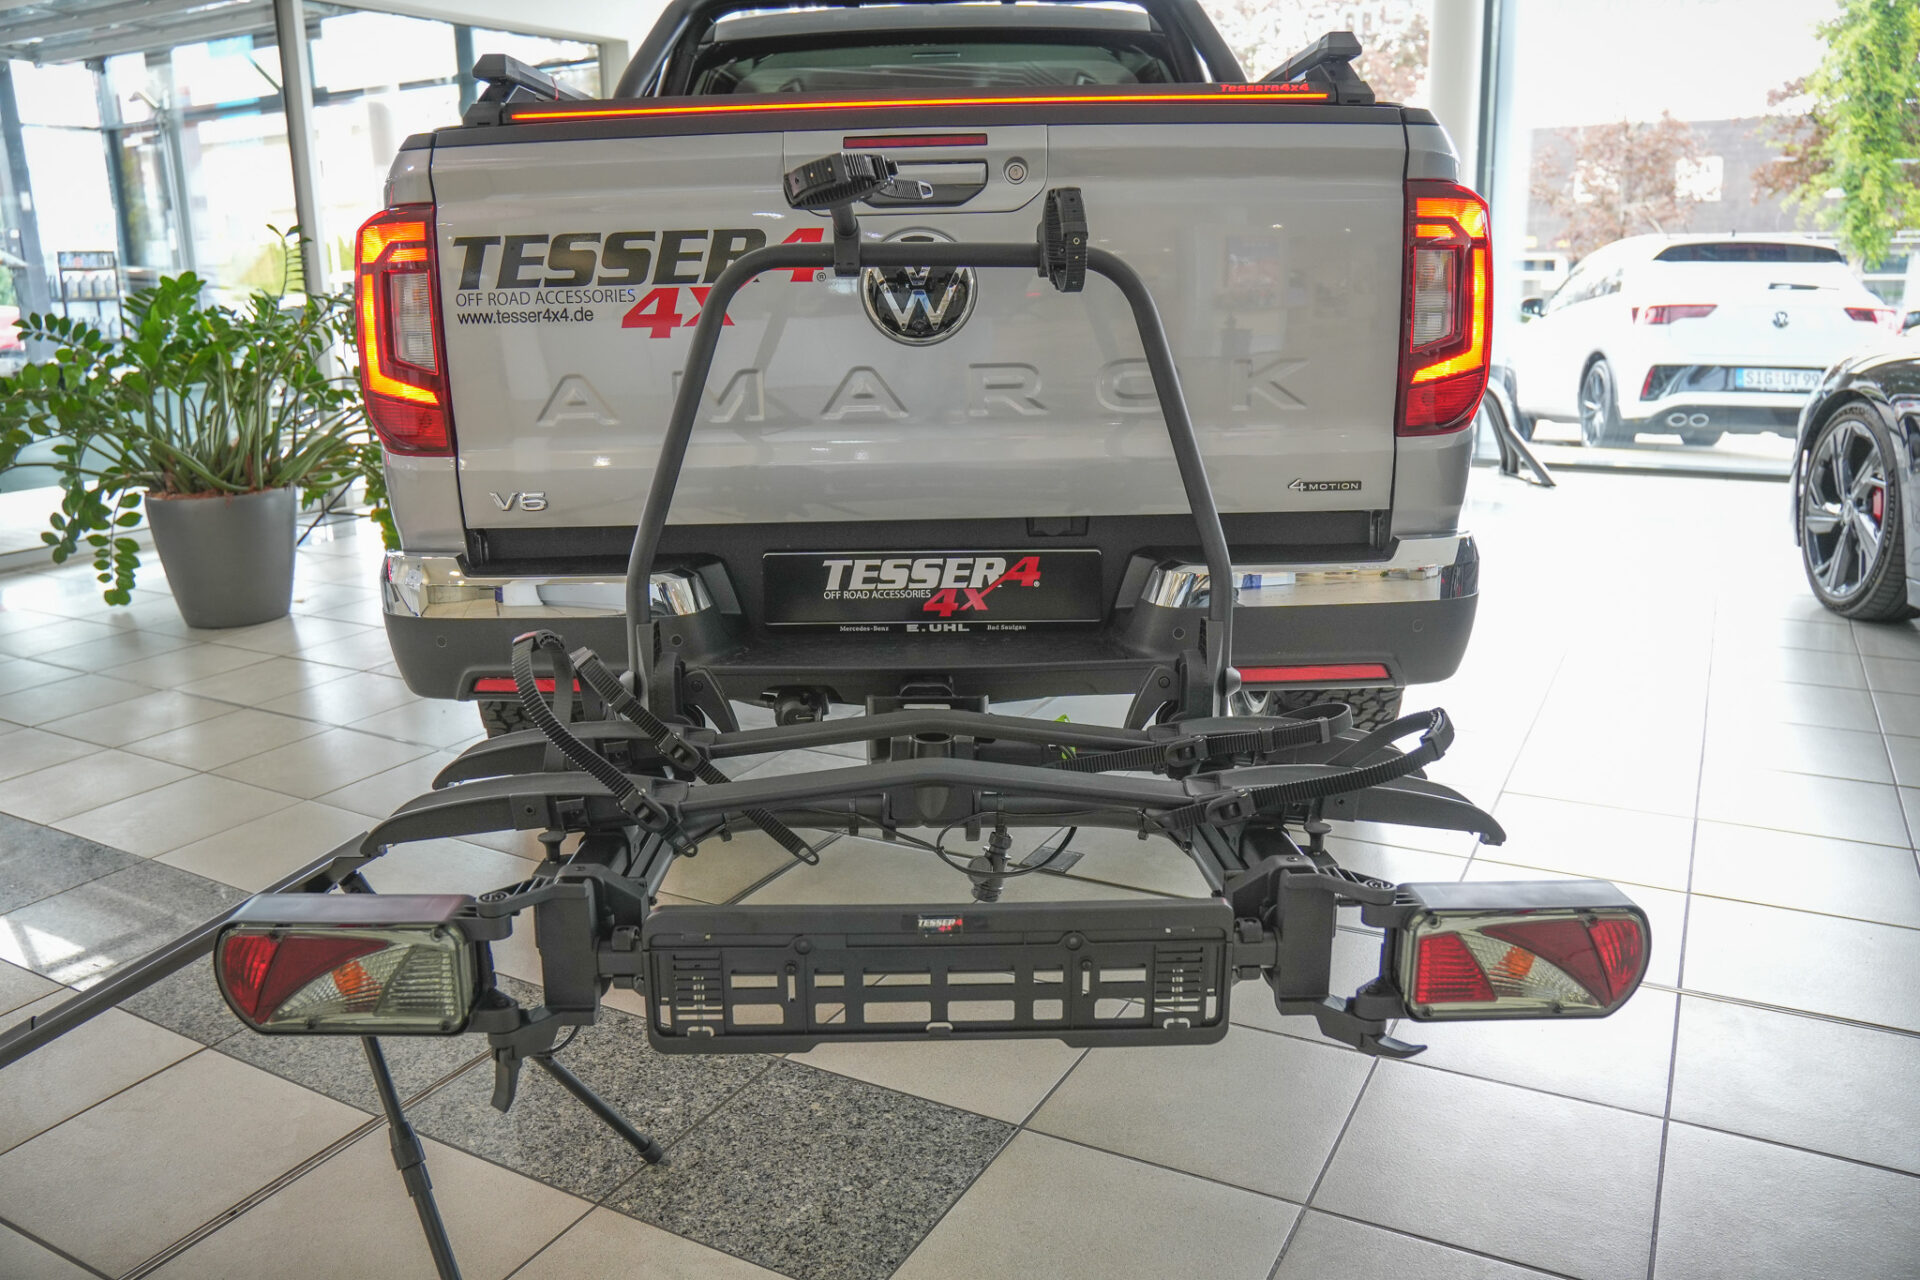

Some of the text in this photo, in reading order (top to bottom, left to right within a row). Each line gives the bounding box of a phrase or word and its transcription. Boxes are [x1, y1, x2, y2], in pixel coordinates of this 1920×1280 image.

[455, 289, 636, 307] OFF ROAD ACCESSORIES
[457, 307, 594, 325] www.tesser4x4.de
[489, 491, 548, 512] V6
[822, 557, 1007, 591] TESSER
[823, 589, 932, 600] OFF ROAD ACCESSORIES
[839, 625, 890, 633] Mercedes-Benz
